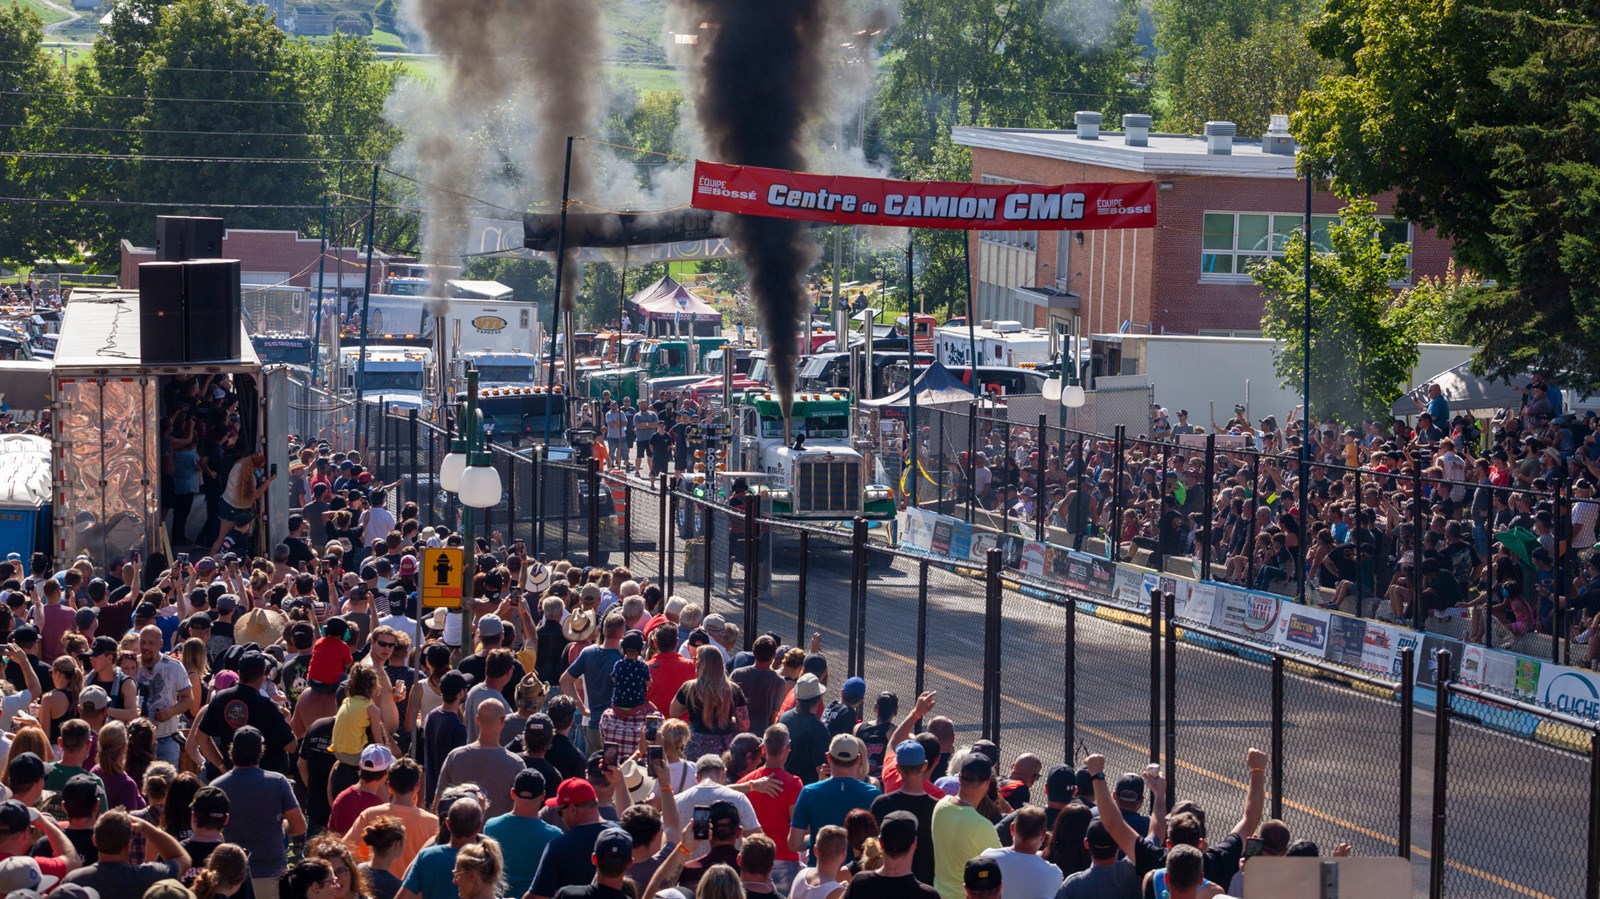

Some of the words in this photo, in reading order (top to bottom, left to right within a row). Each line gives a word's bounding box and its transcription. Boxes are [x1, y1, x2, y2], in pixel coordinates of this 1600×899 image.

[698, 176, 727, 190] ÉQUIPE
[712, 187, 757, 201] BOSSÉ
[766, 183, 857, 214] Centre
[861, 200, 878, 214] du
[883, 193, 997, 220] CAMION
[1003, 192, 1086, 220] CMG
[1097, 198, 1125, 209] ÉQUIPE
[1110, 203, 1152, 215] BOSSÉ
